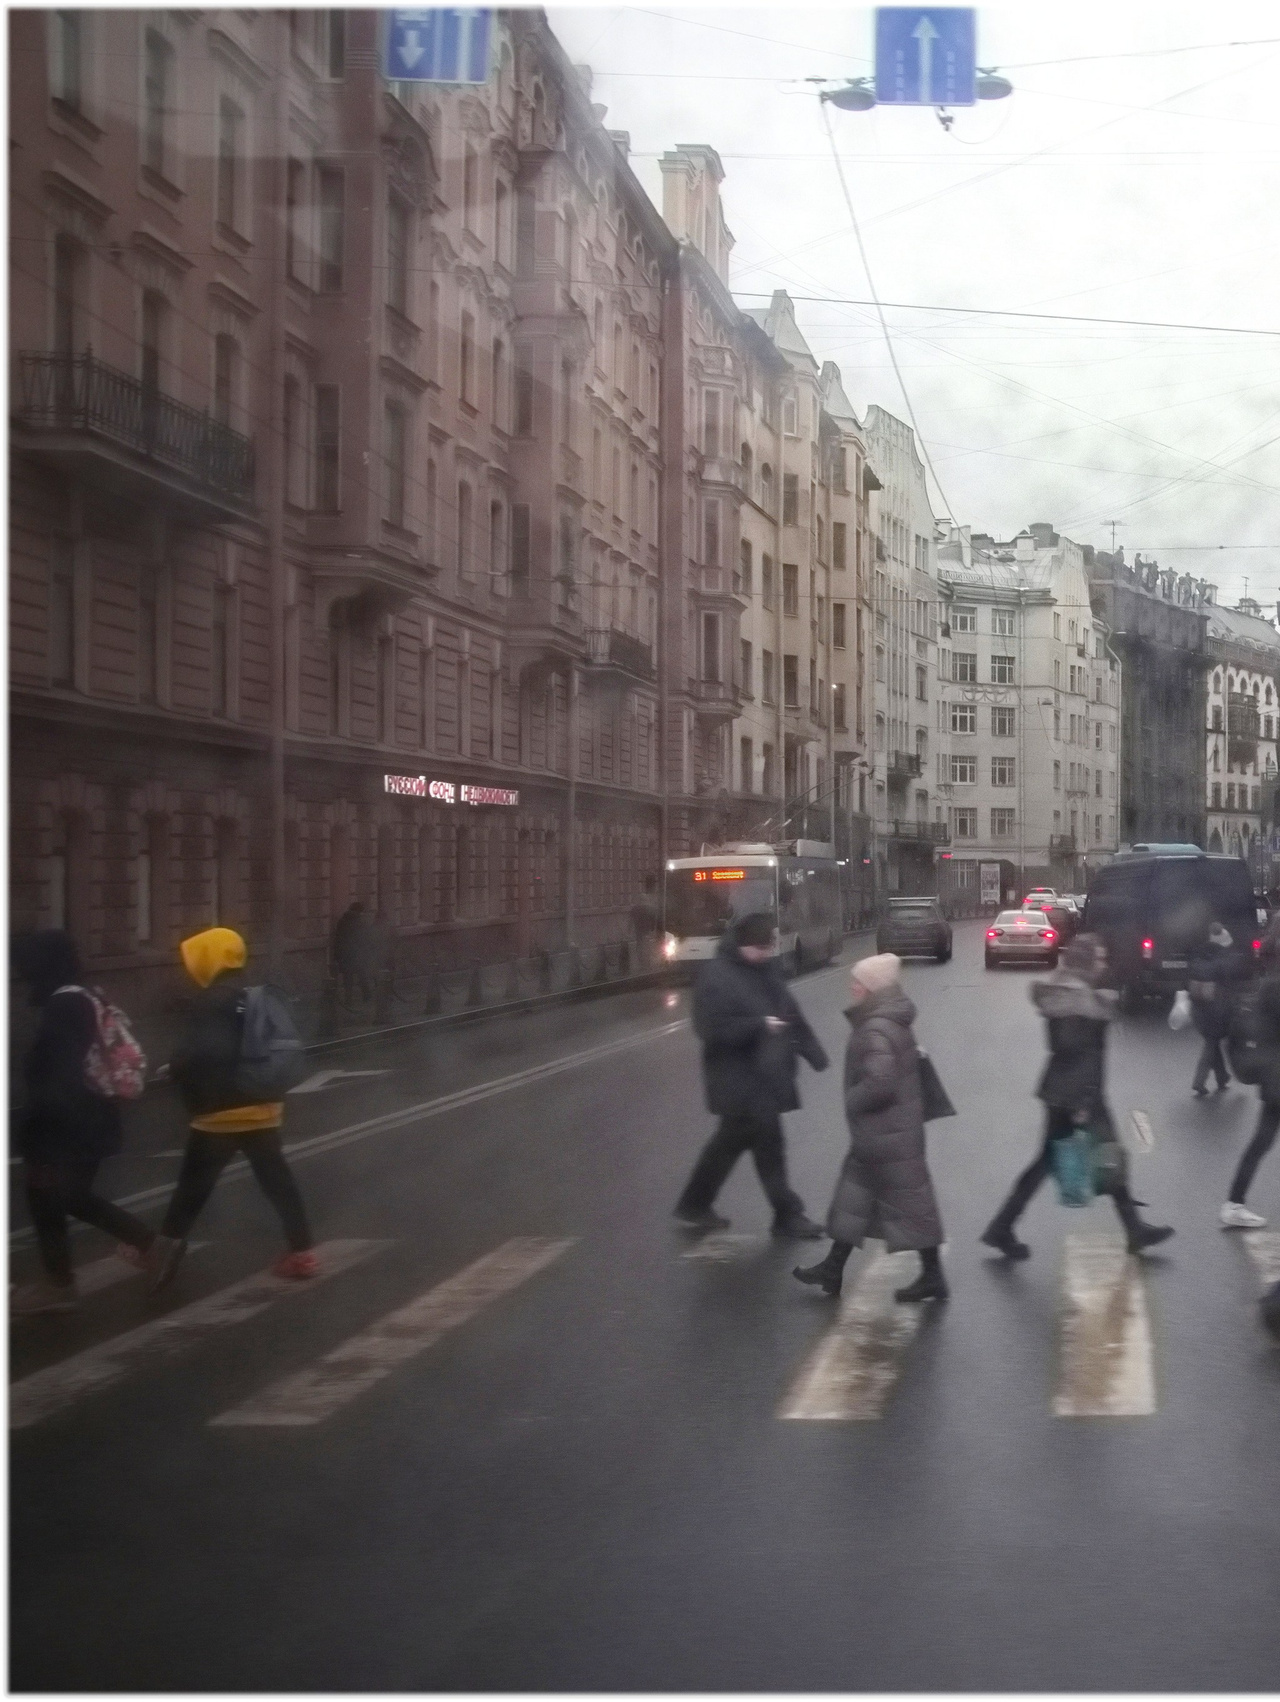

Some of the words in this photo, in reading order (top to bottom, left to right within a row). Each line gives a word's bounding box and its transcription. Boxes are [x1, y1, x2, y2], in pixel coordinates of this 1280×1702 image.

[385, 775, 426, 797] РУССКИЙ
[429, 780, 455, 803] ФОНД
[461, 785, 518, 805] НЕДВИЖИМОСТИ
[694, 871, 707, 881] 31
